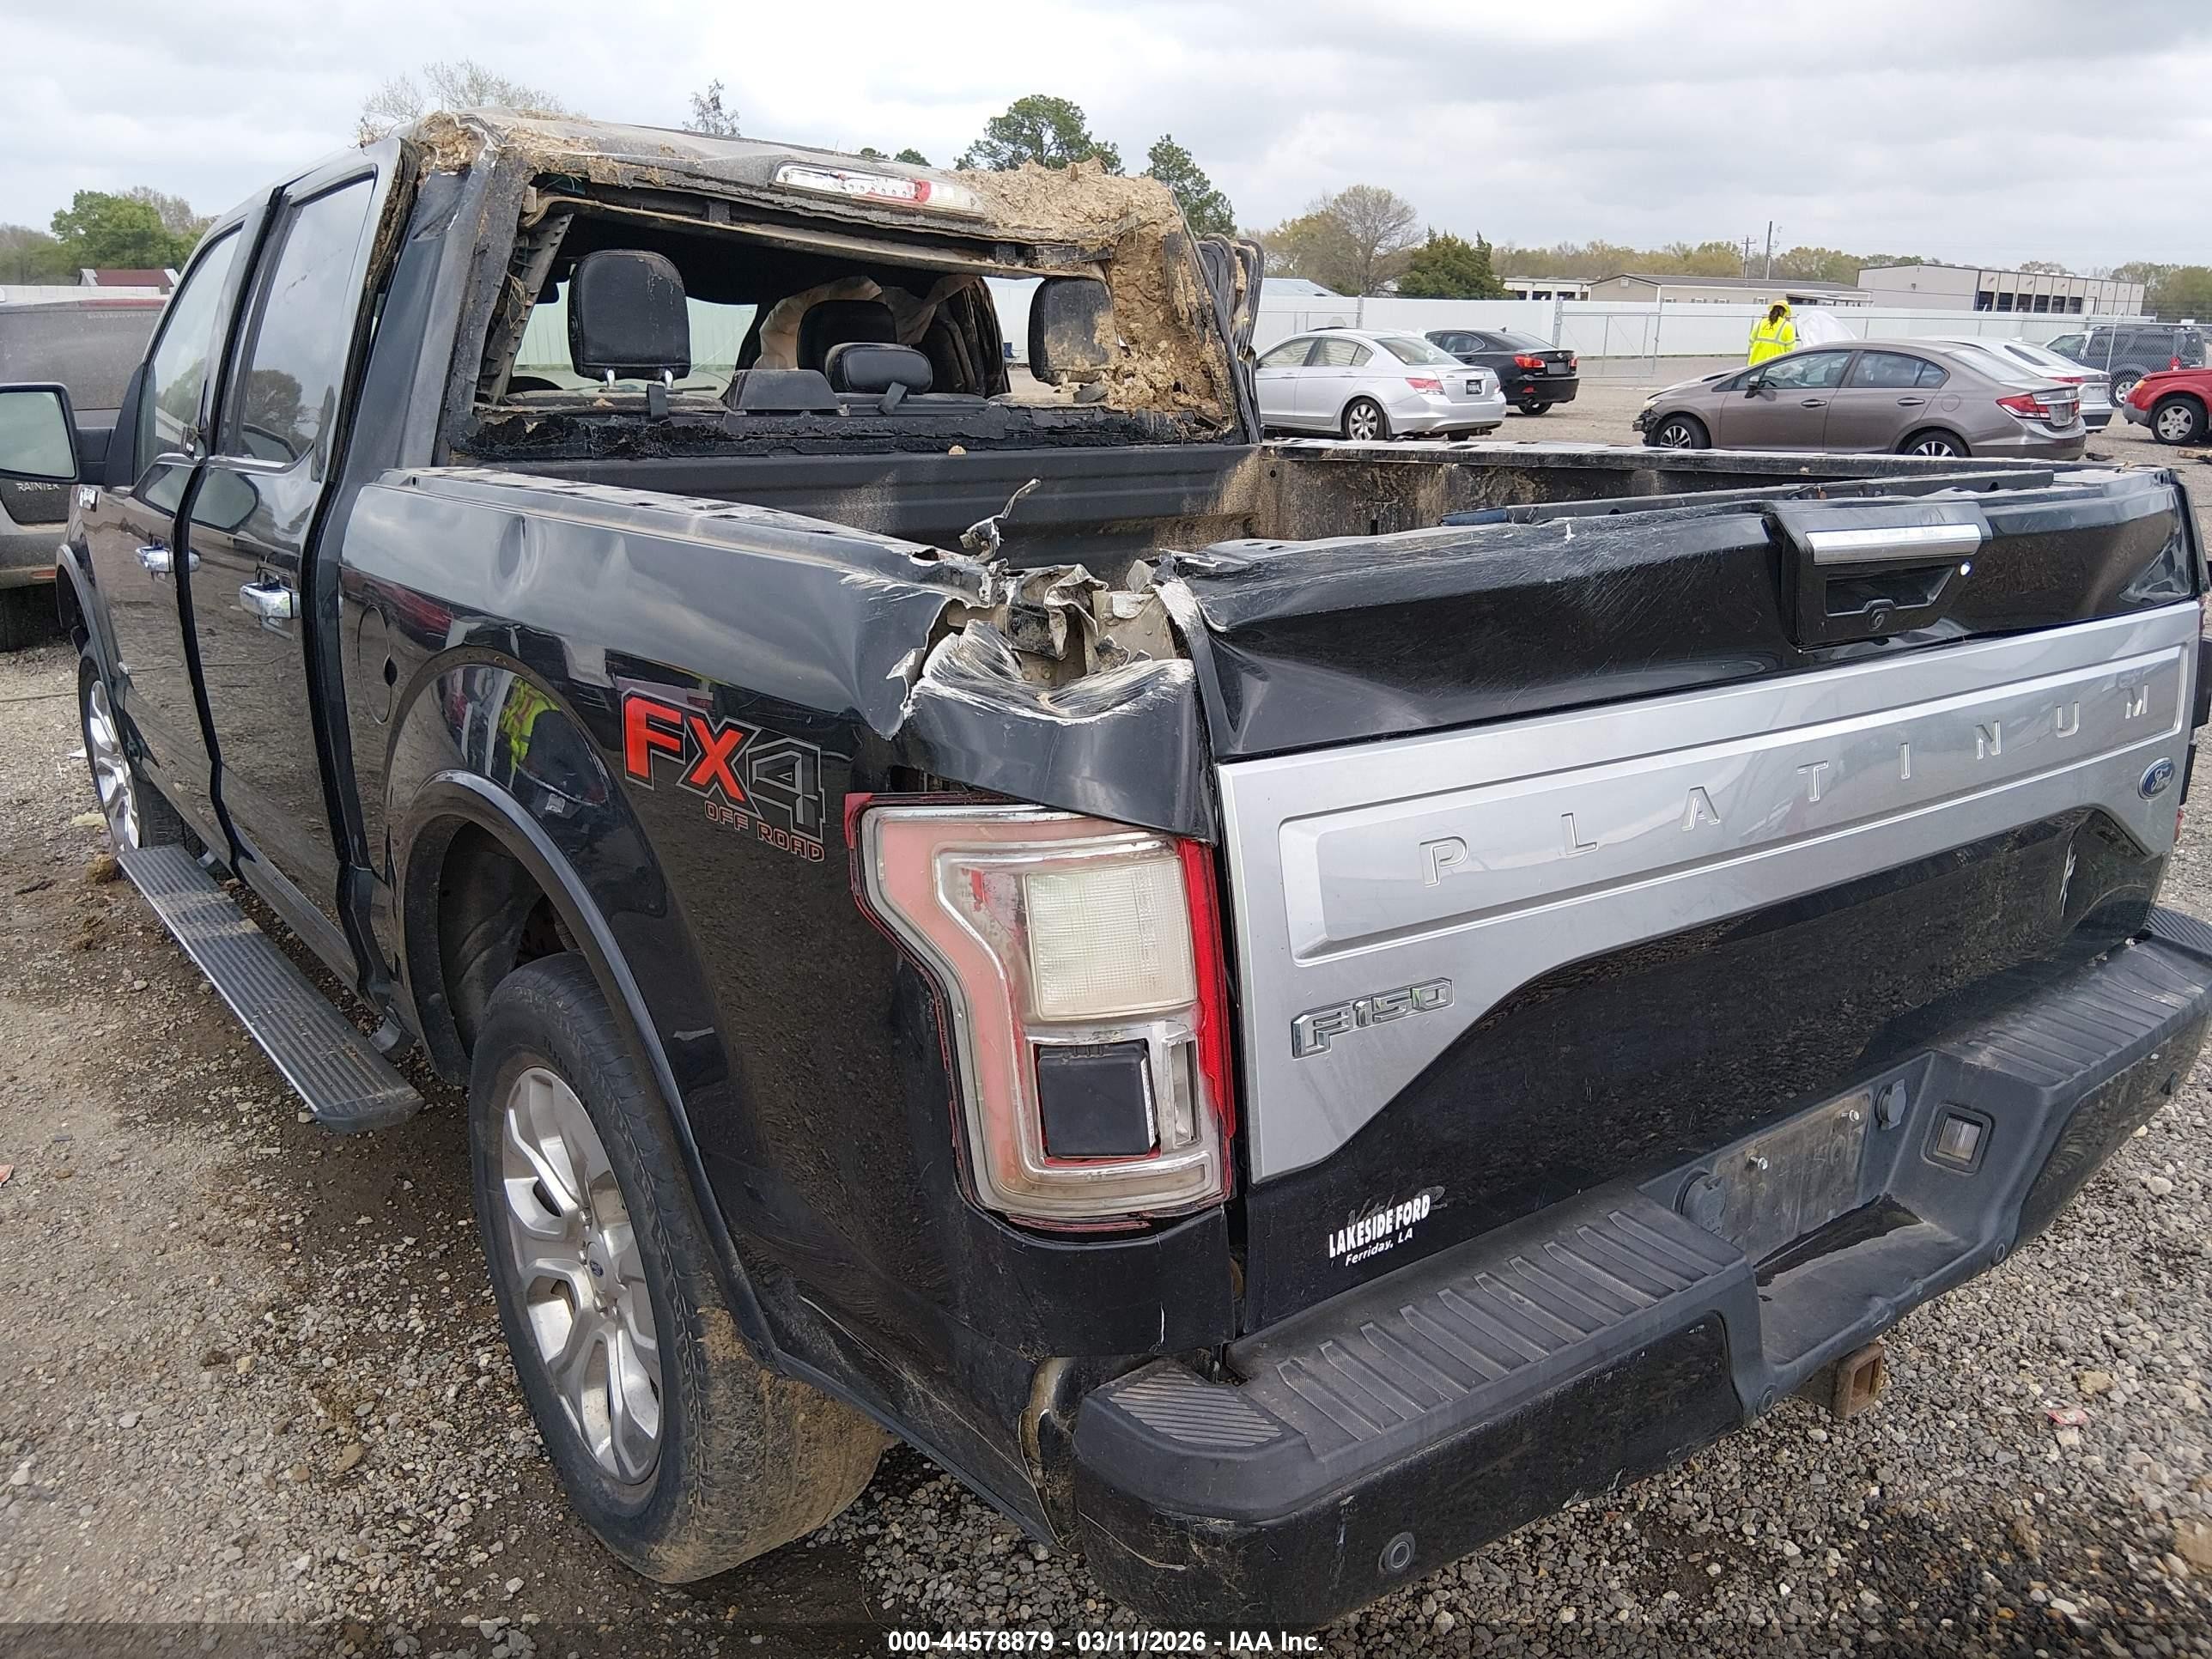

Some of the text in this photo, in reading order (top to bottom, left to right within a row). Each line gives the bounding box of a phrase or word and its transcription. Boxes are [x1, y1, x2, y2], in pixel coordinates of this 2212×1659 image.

[622, 687, 825, 843] FX4
[1419, 684, 2148, 887] PLATINUM
[704, 801, 825, 863] OFF ROAD
[1291, 977, 1454, 1060] F150
[1328, 1194, 1431, 1259] LAKESIDE FORD
[1345, 1227, 1413, 1267] Ferriday, LA
